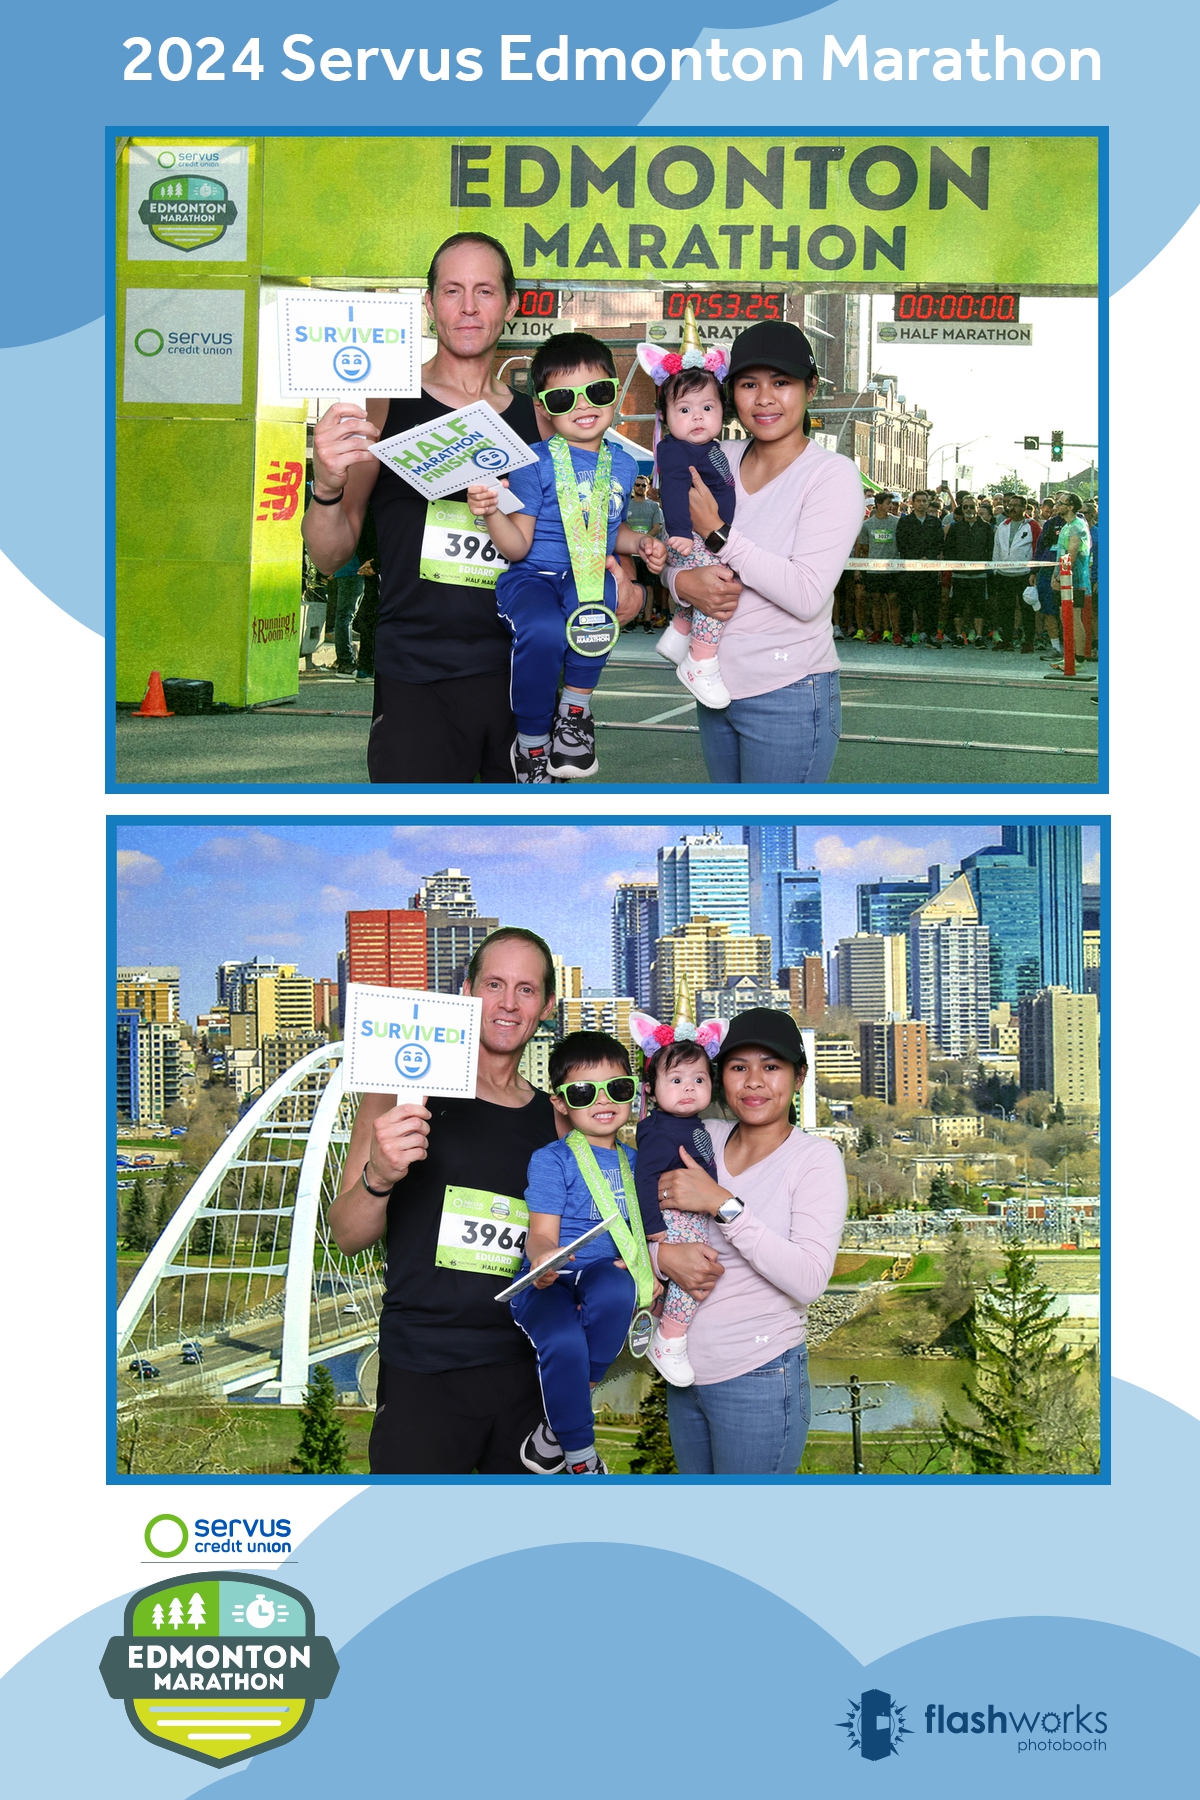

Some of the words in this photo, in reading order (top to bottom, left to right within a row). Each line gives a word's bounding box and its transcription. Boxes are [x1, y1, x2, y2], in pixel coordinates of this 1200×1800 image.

[178, 152, 219, 161] servus
[450, 144, 990, 211] EDMONTON
[149, 203, 226, 213] EDMONTON
[160, 214, 215, 222] MARATHON
[523, 223, 906, 271] MARATHON
[348, 306, 354, 322] I
[295, 326, 406, 345] SURVIVED!
[521, 322, 554, 336] 10K
[900, 328, 939, 339] HALF
[943, 329, 1031, 340] MARATHON
[168, 332, 233, 344] servus
[168, 345, 200, 355] credit
[203, 346, 232, 355] union
[391, 417, 468, 470] HALF
[411, 430, 484, 476] MARATHON
[420, 437, 497, 484] FINISHER!
[458, 565, 495, 577] EDUARD
[413, 1004, 419, 1020] I
[361, 1020, 466, 1044] SURVIVED!
[461, 1220, 527, 1254] 3964
[476, 1253, 512, 1264] EDUARD
[482, 1264, 498, 1272] HALF
